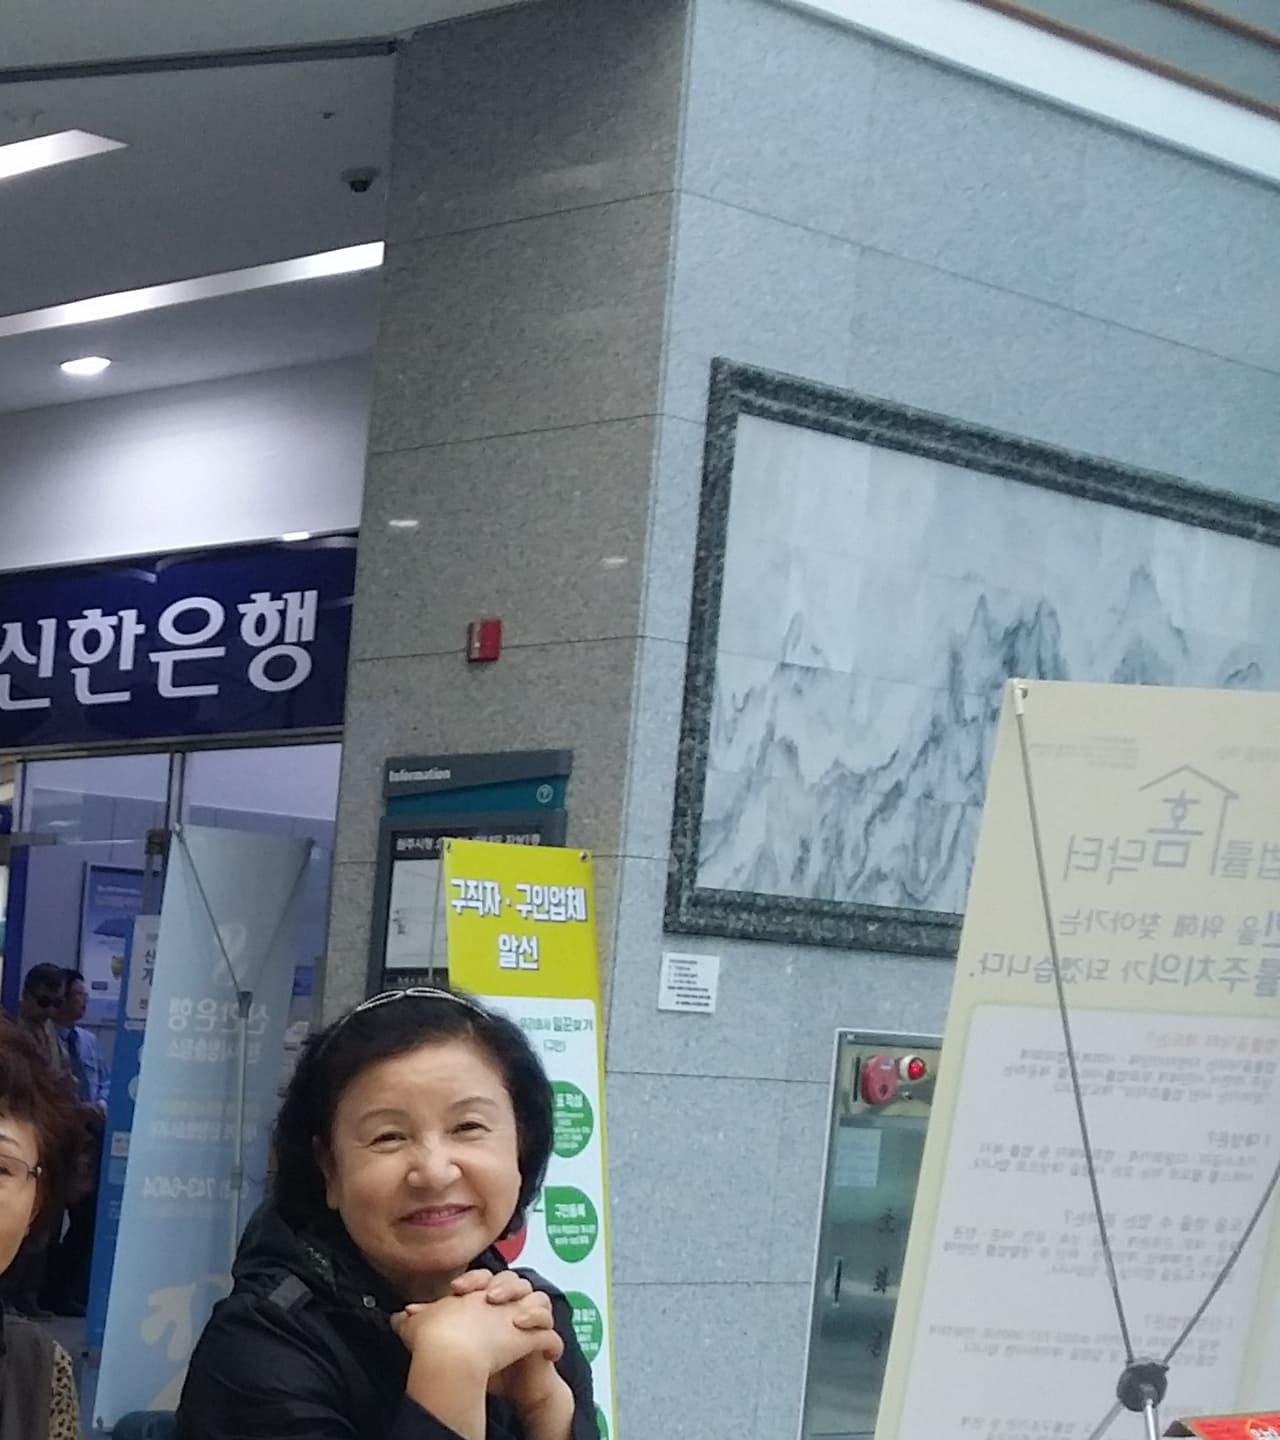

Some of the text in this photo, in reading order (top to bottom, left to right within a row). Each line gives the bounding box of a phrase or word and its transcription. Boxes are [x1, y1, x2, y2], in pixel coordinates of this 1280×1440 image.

[451, 878, 588, 921] 구직자 구인업체
[498, 934, 539, 970] 알선
